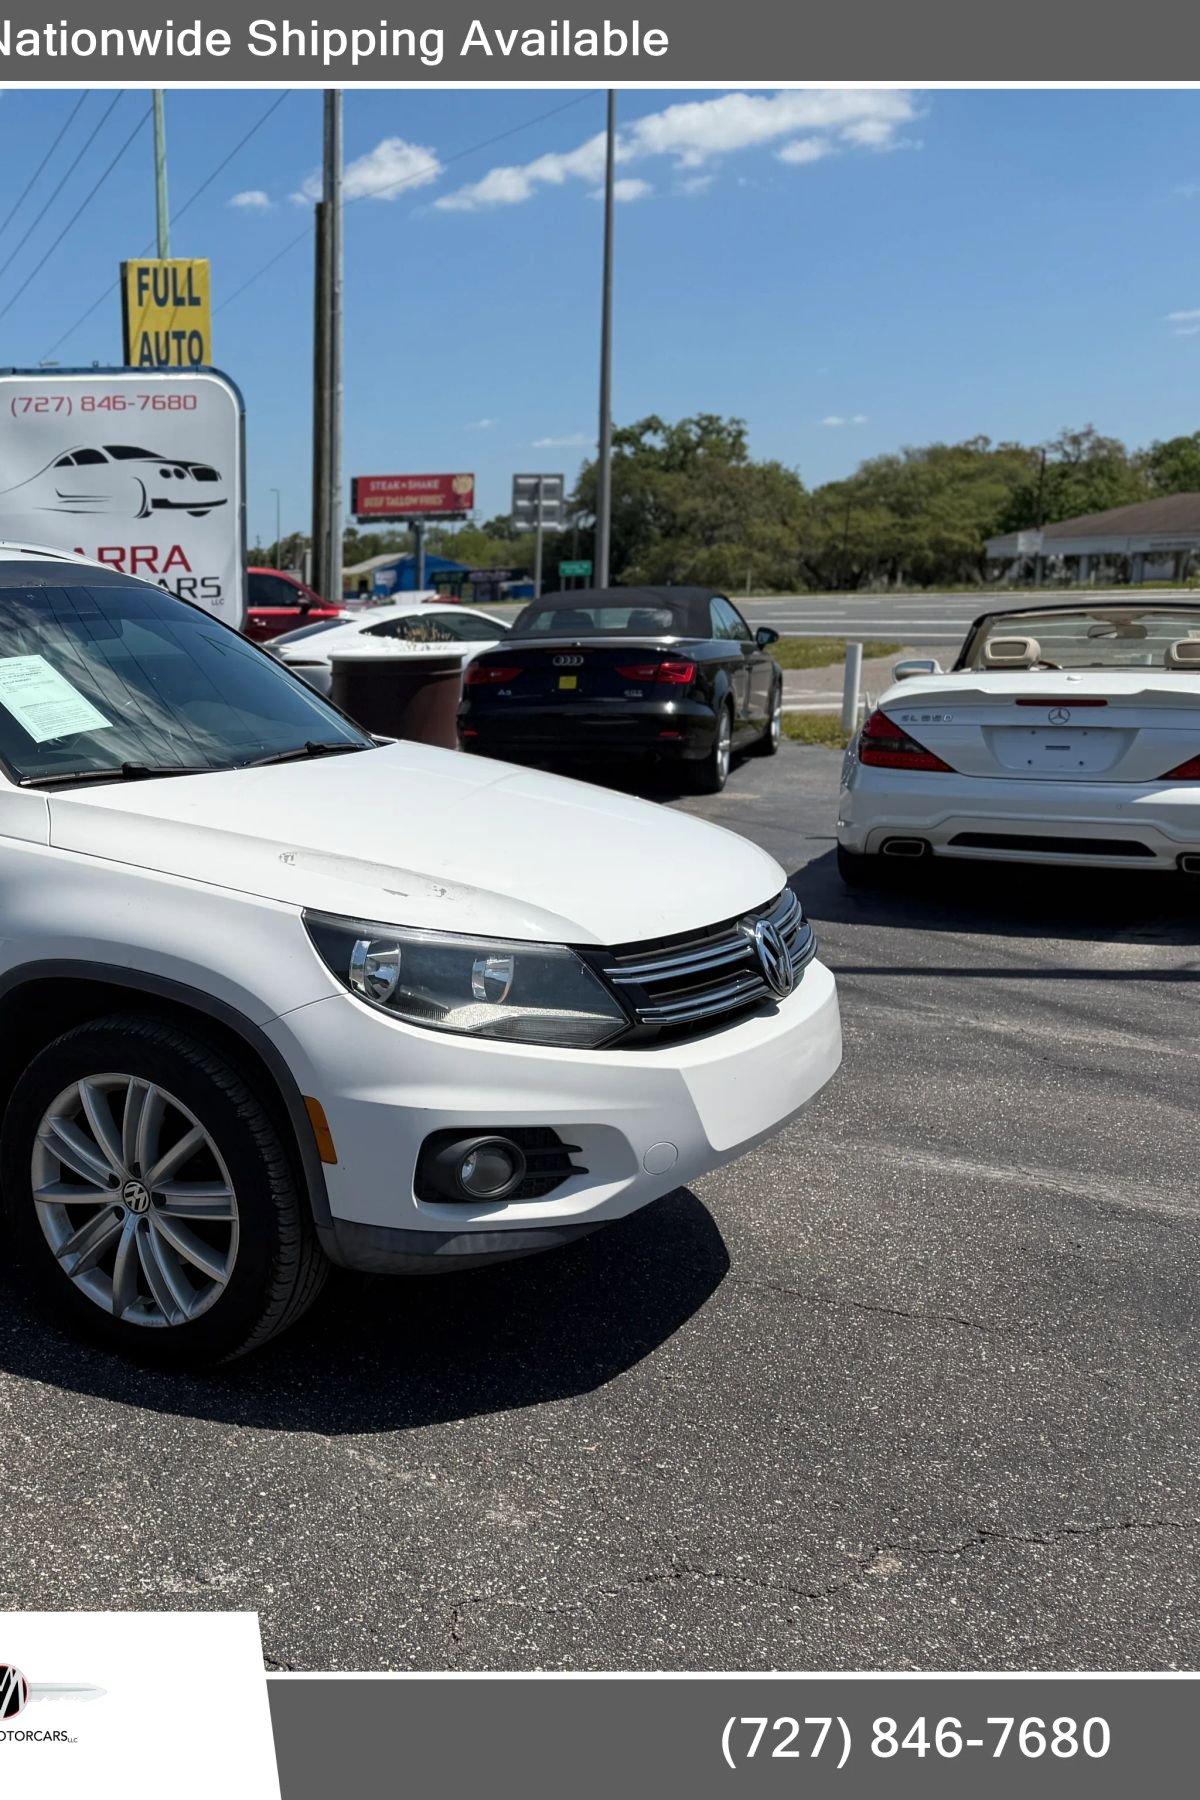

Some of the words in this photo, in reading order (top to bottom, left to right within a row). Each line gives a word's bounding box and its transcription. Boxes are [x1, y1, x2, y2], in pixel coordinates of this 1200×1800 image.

[136, 266, 202, 308] FULL
[138, 330, 205, 367] AUTO
[10, 396, 73, 417] (727)
[80, 394, 198, 413] 846-7680
